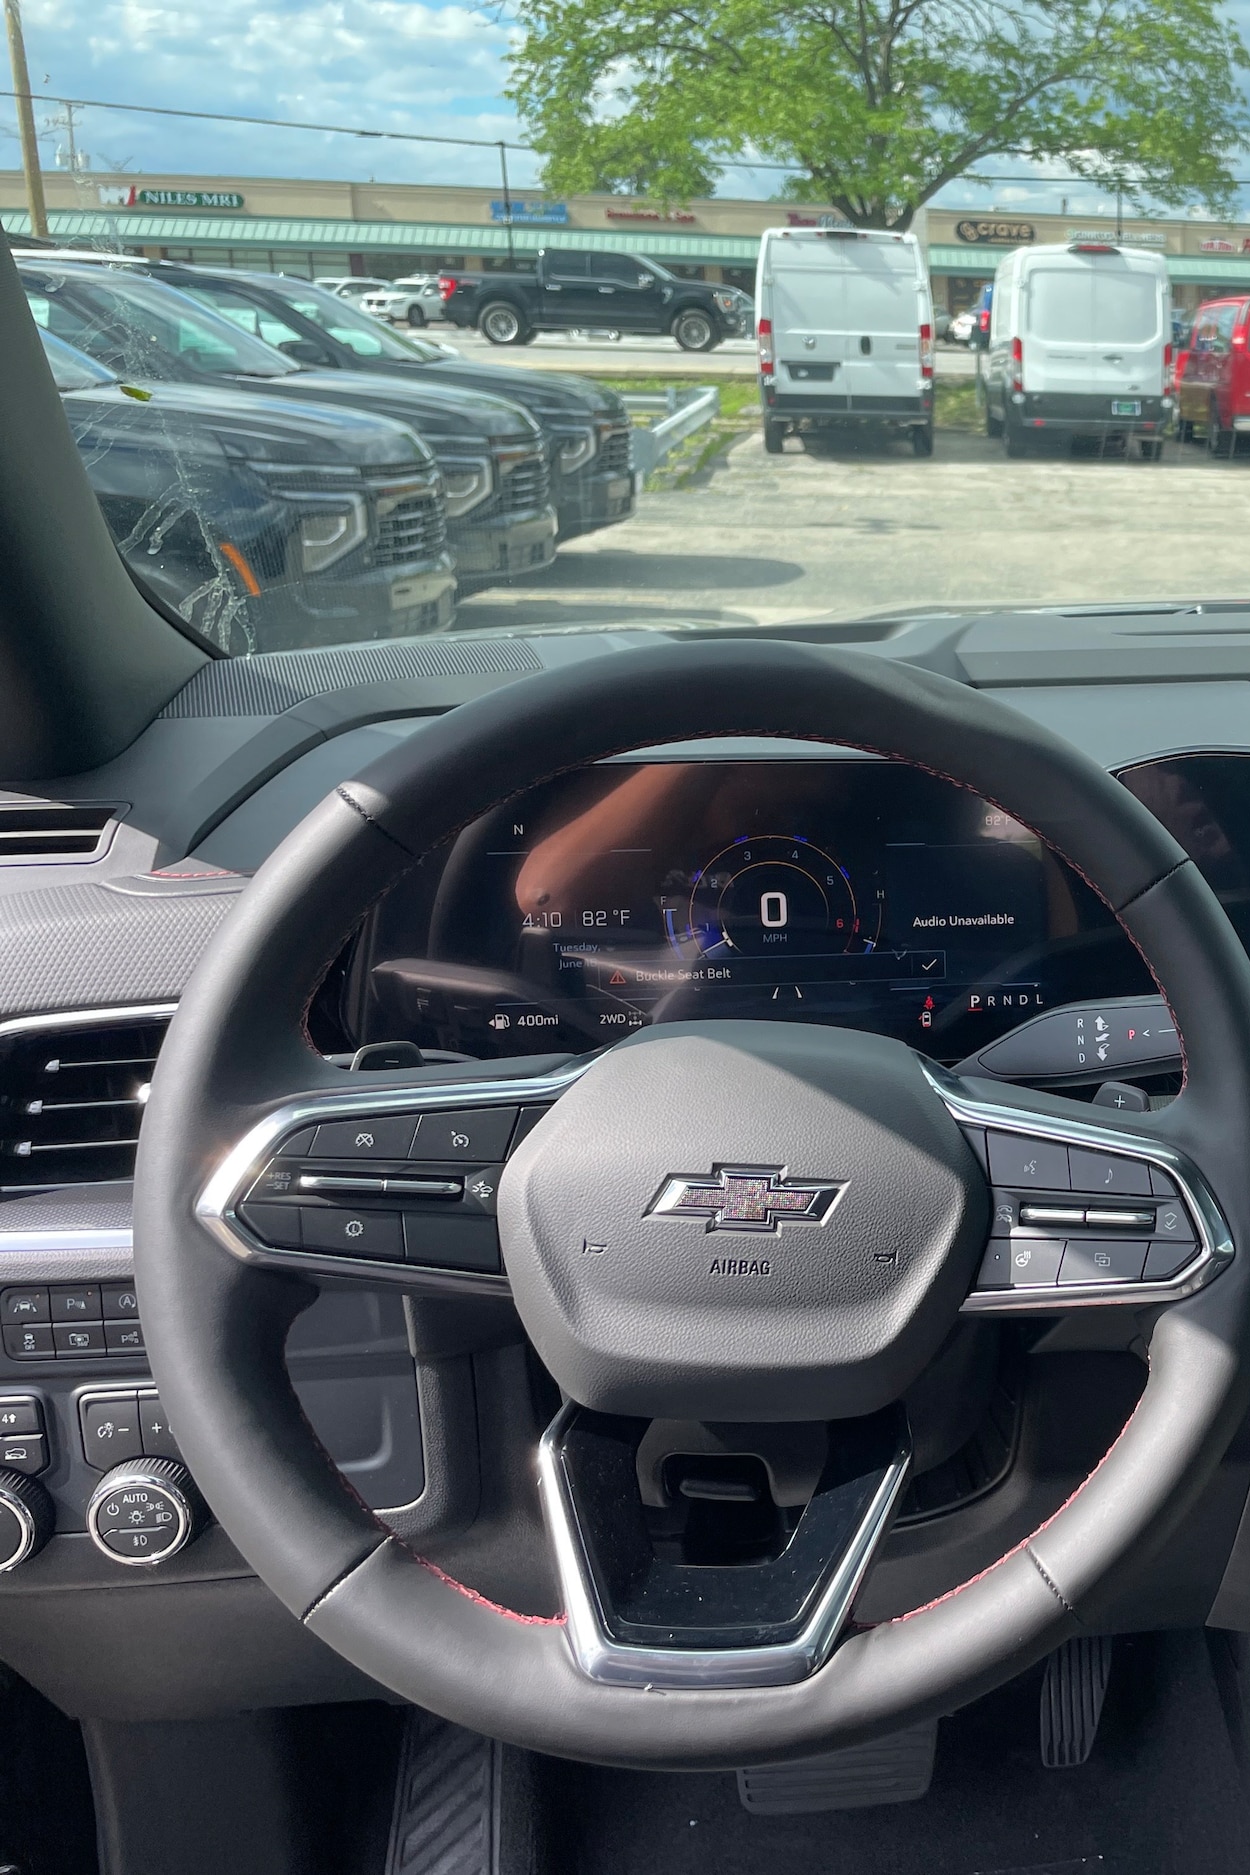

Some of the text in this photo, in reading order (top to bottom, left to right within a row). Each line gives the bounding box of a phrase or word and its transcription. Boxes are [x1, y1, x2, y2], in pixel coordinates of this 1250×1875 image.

[144, 190, 197, 206] NILES
[201, 193, 239, 208] MRI
[977, 221, 1031, 238] crave
[513, 824, 524, 836] N
[743, 850, 752, 861] 3
[791, 849, 800, 860] 4
[710, 878, 719, 889] 2
[826, 875, 835, 886] 5
[876, 889, 886, 900] H
[659, 895, 667, 907] F
[760, 891, 789, 928] 0
[522, 911, 562, 928] 4:10
[836, 918, 844, 929] 6
[913, 913, 1015, 928] Audio Unavailable
[762, 933, 788, 943] MPH
[559, 958, 583, 971] June
[635, 967, 732, 982] Buckle Seat Belt
[970, 994, 1044, 1008] P R N D L
[517, 1013, 559, 1027] 400mi
[599, 1013, 627, 1025] 2WD
[1077, 1018, 1084, 1029] R
[1128, 1029, 1136, 1040] P
[1077, 1035, 1085, 1046] N
[1078, 1052, 1086, 1063] D
[709, 1258, 771, 1276] AIRBAG
[24, 1342, 35, 1350] OFF
[122, 1492, 149, 1503] AUTO
